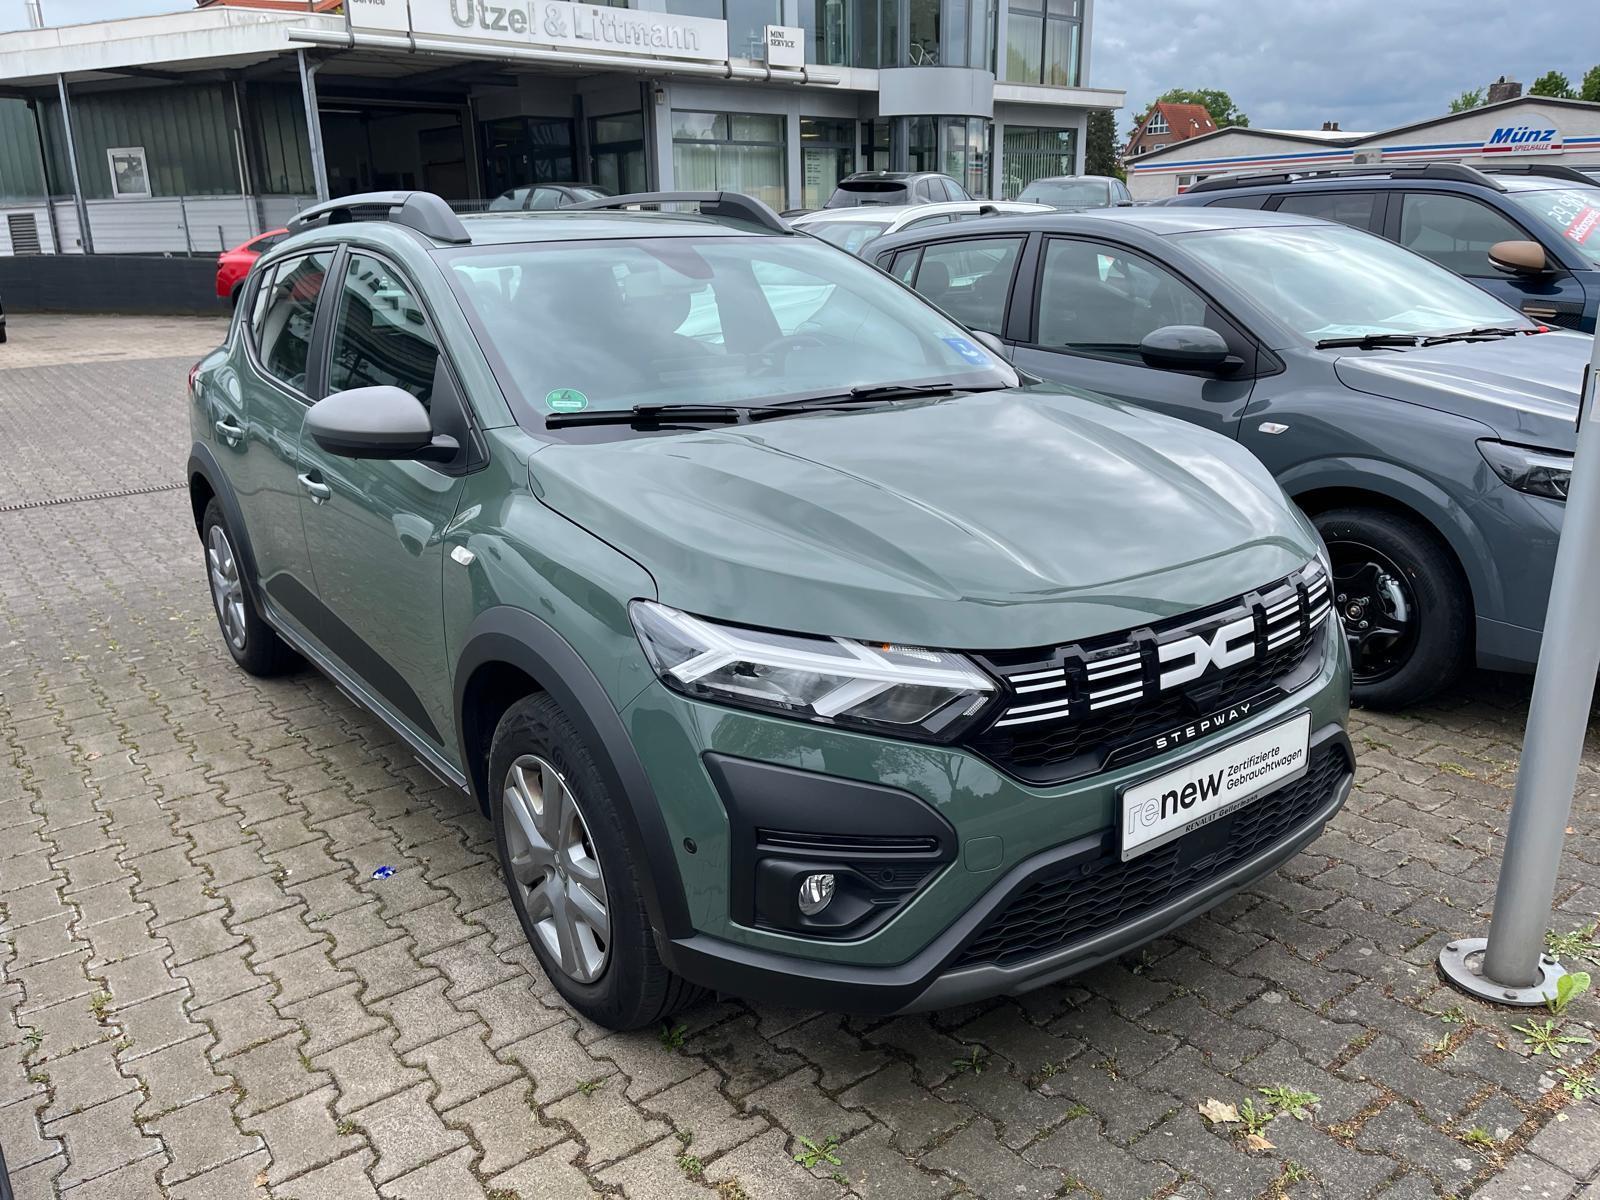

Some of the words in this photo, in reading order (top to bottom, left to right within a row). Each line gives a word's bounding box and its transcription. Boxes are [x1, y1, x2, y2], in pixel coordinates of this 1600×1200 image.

[451, 0, 537, 35] Utzel
[544, 3, 568, 38] &
[573, 6, 700, 51] Littmann
[770, 30, 785, 39] MINI
[770, 39, 796, 48] SERVICE
[1488, 126, 1556, 144] Münz
[1513, 143, 1551, 152] SPIELHALLE
[1156, 703, 1251, 749] STEPWAY
[1226, 748, 1302, 790] Gebrauchtwagen
[1227, 745, 1280, 777] Zertifizierte
[1128, 769, 1224, 835] renew
[1185, 813, 1217, 832] RENAULT
